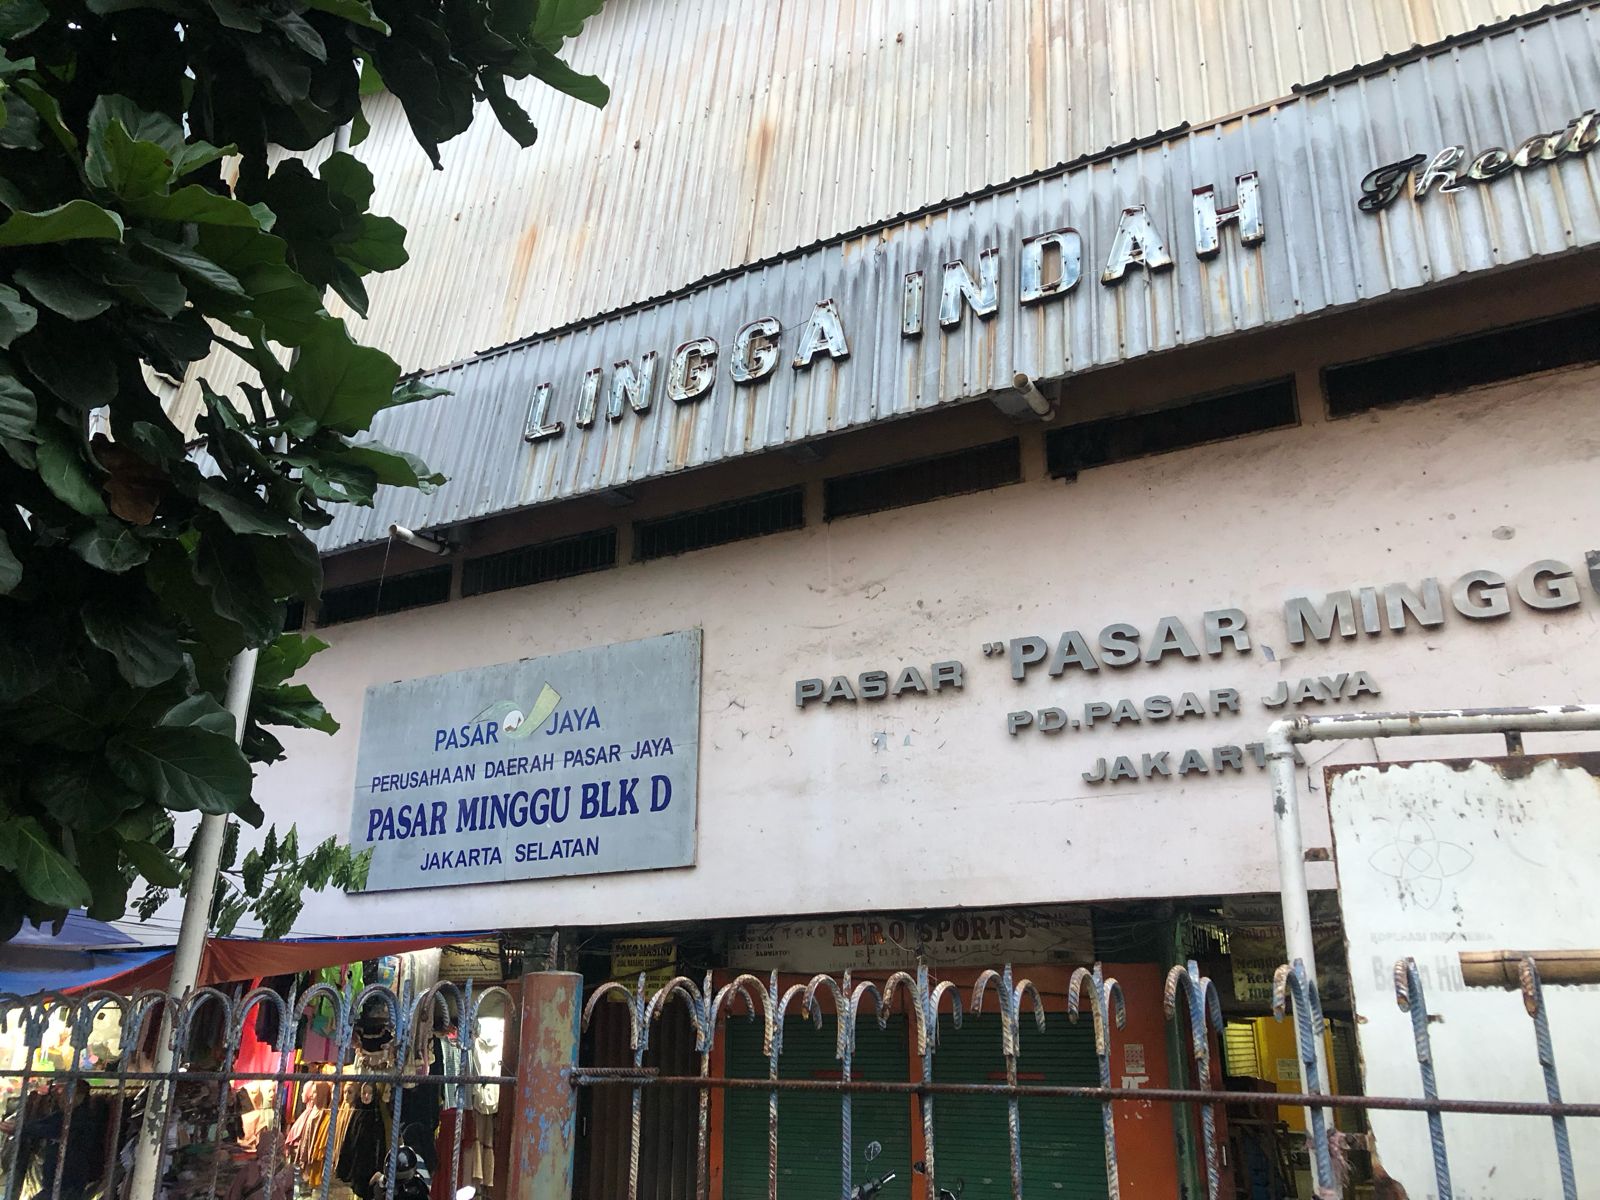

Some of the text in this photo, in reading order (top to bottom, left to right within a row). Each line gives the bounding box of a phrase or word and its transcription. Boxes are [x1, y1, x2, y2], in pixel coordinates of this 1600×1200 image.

[524, 298, 850, 443] LINGGA
[901, 173, 1266, 339] INDAH
[795, 659, 965, 708] PASAR
[1261, 669, 1381, 710] JAYA
[434, 705, 600, 752] PASAR JAYA
[371, 736, 674, 793] PERUSAHAAN DAERAH PASAR JAYA
[366, 774, 672, 842] PASAR MINGGU BLK D
[420, 836, 600, 871] JAKARTA SELATAN
[832, 920, 905, 946] HERO
[919, 913, 1027, 942] SPORTS
